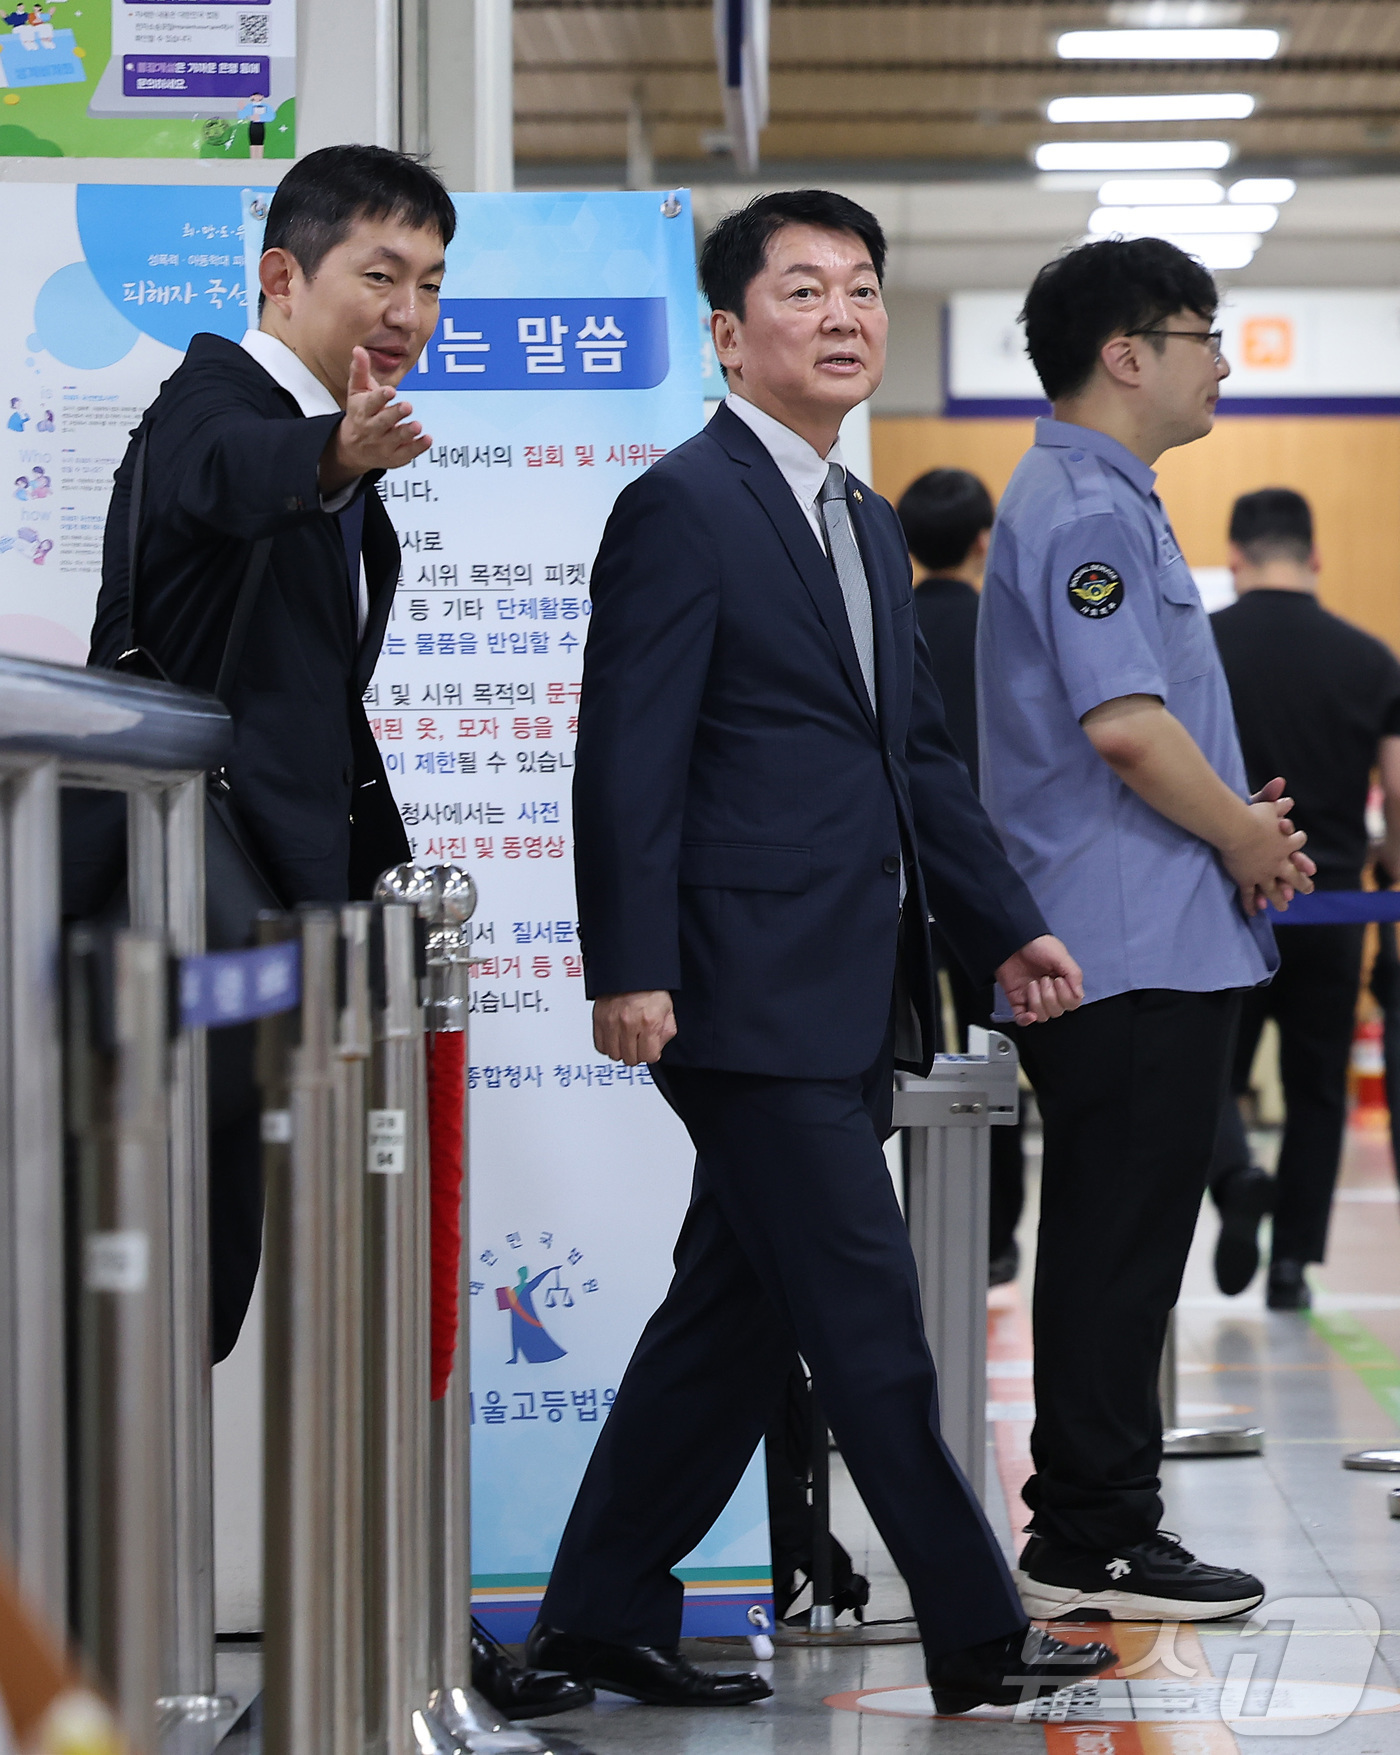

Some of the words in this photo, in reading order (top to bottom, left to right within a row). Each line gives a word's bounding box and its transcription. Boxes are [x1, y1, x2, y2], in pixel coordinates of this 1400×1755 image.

[122, 279, 198, 306] 피해자
[417, 316, 490, 374] 는
[517, 315, 628, 374] 말씀
[430, 445, 513, 468] 내에서의
[523, 445, 564, 468] 집회
[575, 445, 595, 467] 및
[396, 530, 443, 553] 사로
[417, 563, 459, 587] 시위
[470, 563, 533, 587] 목적의
[409, 598, 430, 621] 등
[443, 598, 484, 621] 기타
[415, 632, 478, 655] 물품을
[487, 631, 550, 655] 반입할
[558, 631, 580, 653] 수
[391, 683, 411, 706] 및
[422, 683, 462, 706] 시위
[473, 682, 536, 706] 목적의
[457, 717, 499, 740] 모자
[511, 716, 554, 739] 등을
[414, 751, 478, 775] 제한될
[486, 751, 507, 774] 수
[400, 802, 505, 825] 청사에서는
[517, 801, 561, 824] 사전
[425, 836, 467, 859] 사진
[474, 836, 494, 859] 및
[502, 835, 565, 859] 동영상
[512, 920, 581, 944] 질서문
[531, 955, 552, 978] 등
[469, 1387, 617, 1426] 울고등법
